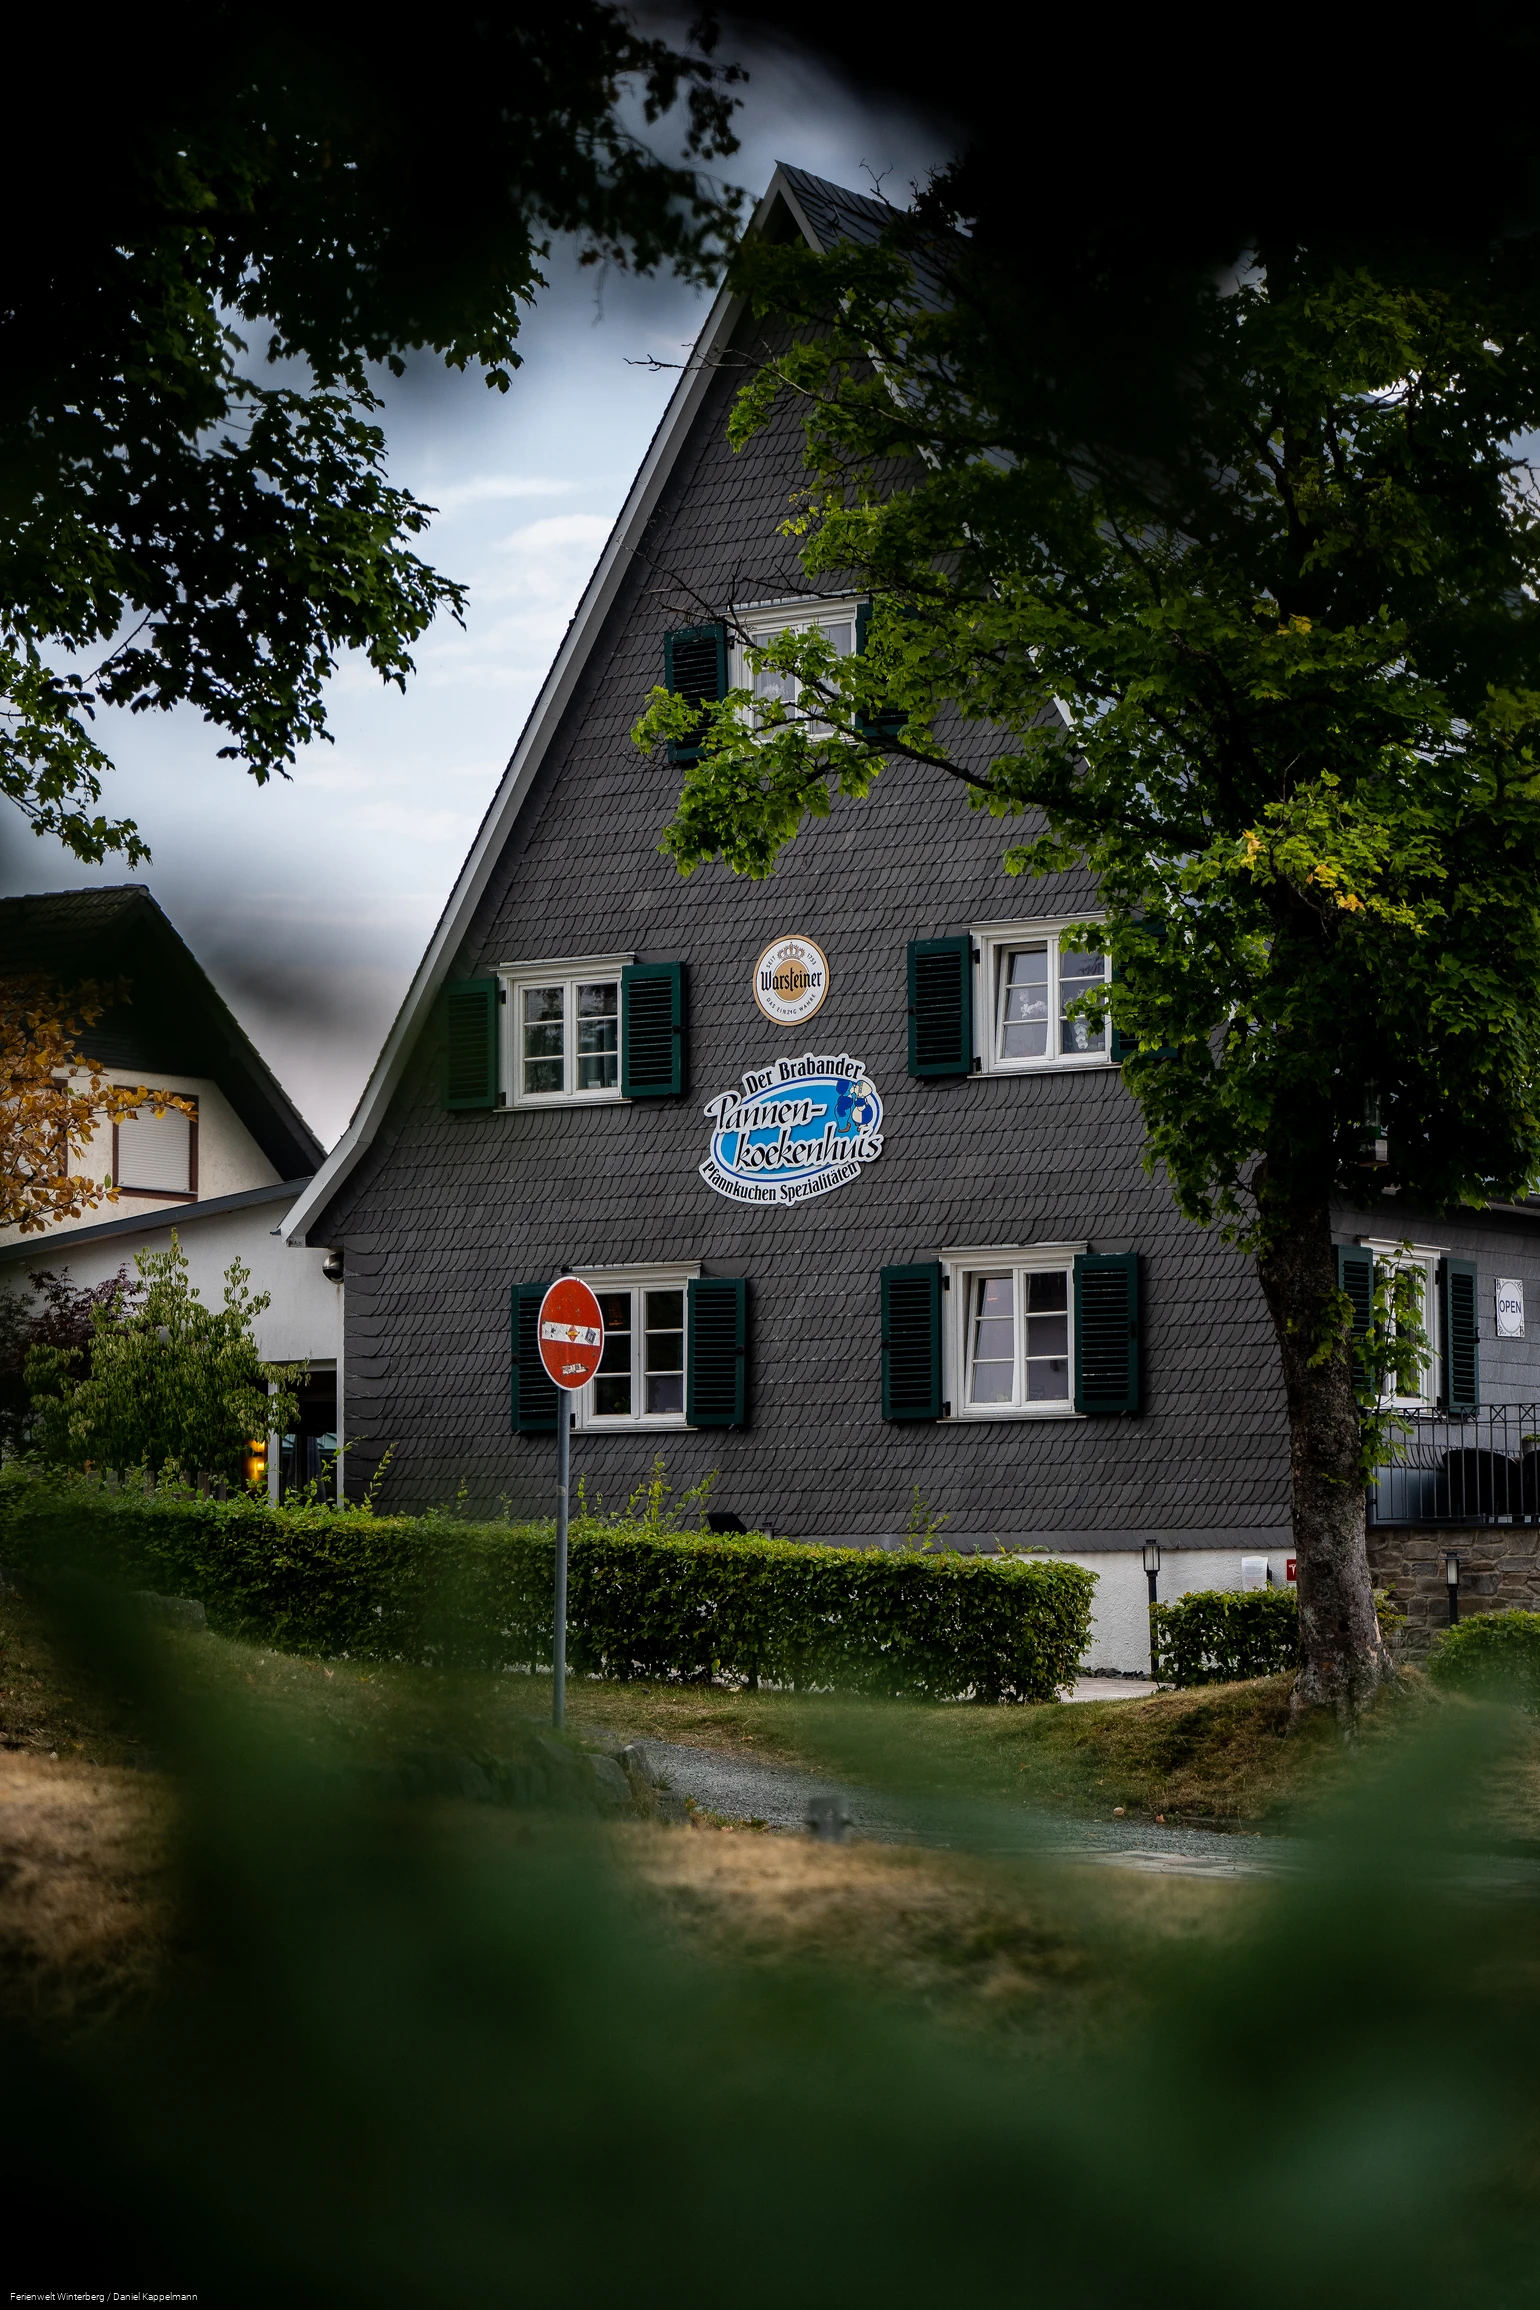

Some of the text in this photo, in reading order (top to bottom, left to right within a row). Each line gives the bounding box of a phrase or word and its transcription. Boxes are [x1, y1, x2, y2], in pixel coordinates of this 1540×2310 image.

[766, 953, 817, 969] SEIT 1753
[761, 967, 822, 992] Warsteiner
[766, 997, 776, 1009] DAS
[799, 993, 816, 1011] WAHRE
[745, 1057, 863, 1094] Der Brabander
[706, 1094, 824, 1130] Pannen-
[735, 1125, 880, 1168] koekenhuis
[702, 1160, 858, 1202] Pfannkuchen Spezialitäten
[1499, 1299, 1521, 1313] OPEN
